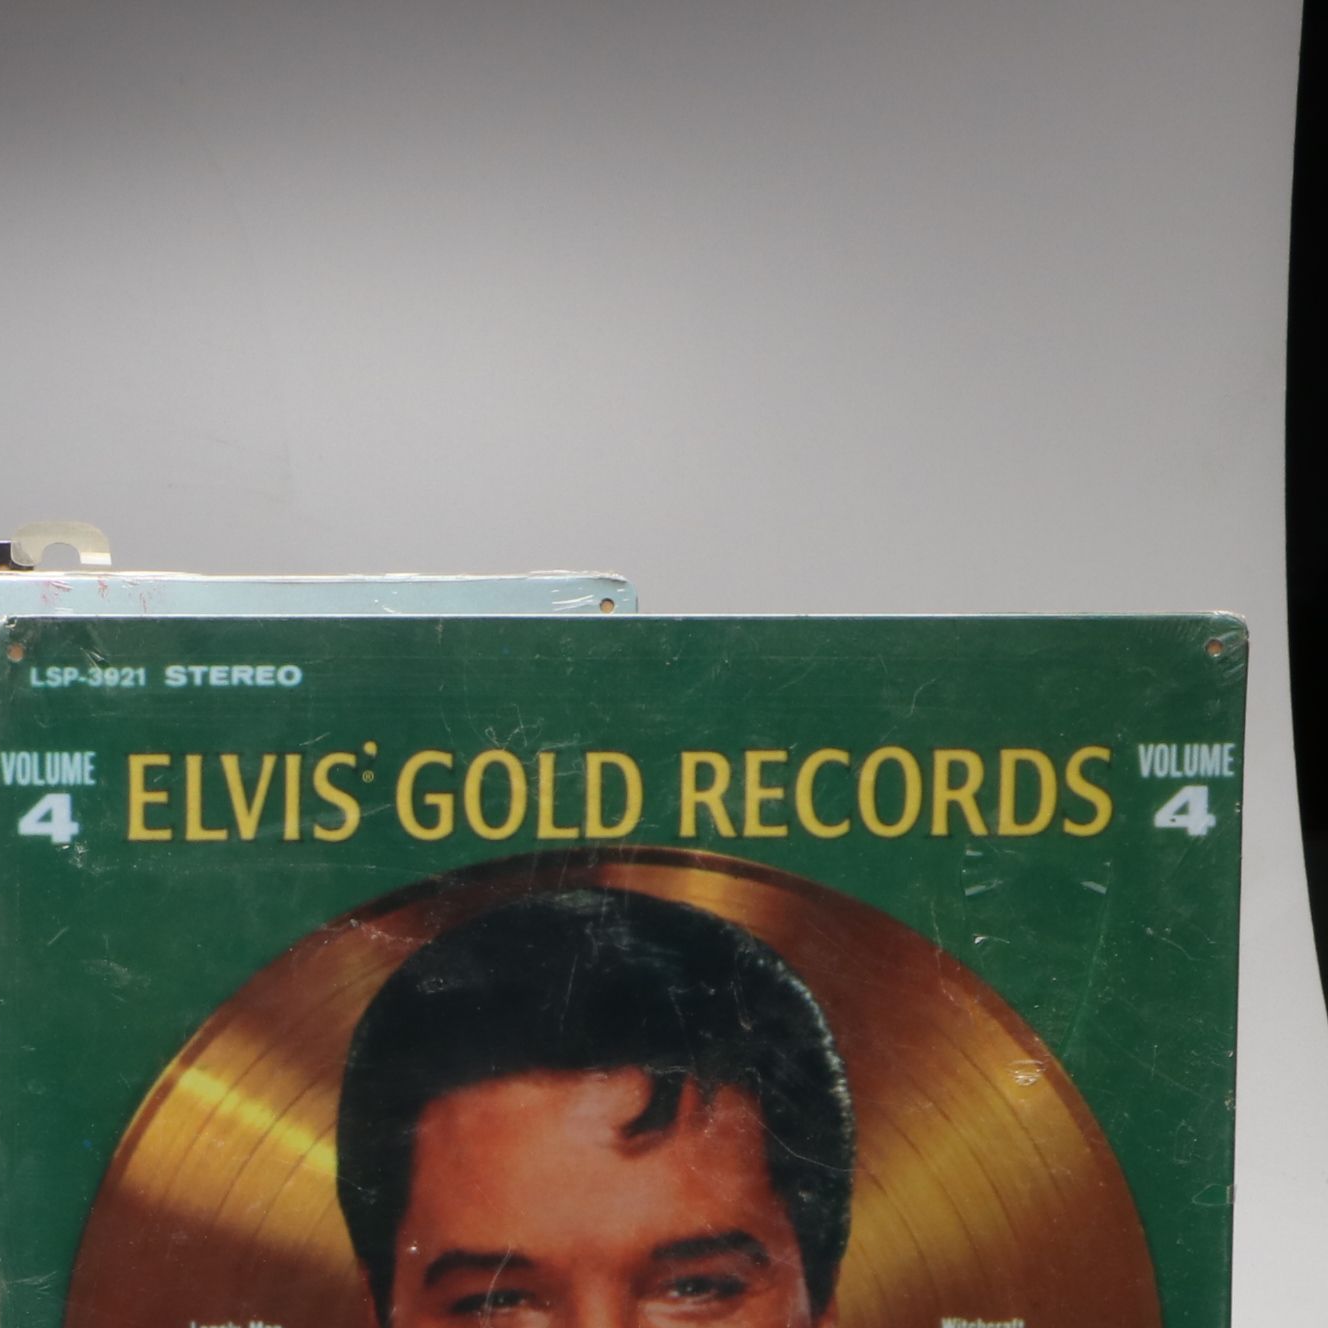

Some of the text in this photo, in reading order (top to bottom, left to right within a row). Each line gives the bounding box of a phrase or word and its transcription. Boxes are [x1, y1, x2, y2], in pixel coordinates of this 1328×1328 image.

[30, 665, 303, 688] LSP-3921 STEREO
[1, 750, 96, 787] VOLUME
[1138, 743, 1236, 779] VOLUME
[395, 749, 644, 841] GOLD
[678, 745, 1113, 838] RECORDS
[1153, 785, 1217, 837] 4
[17, 793, 80, 844] 4
